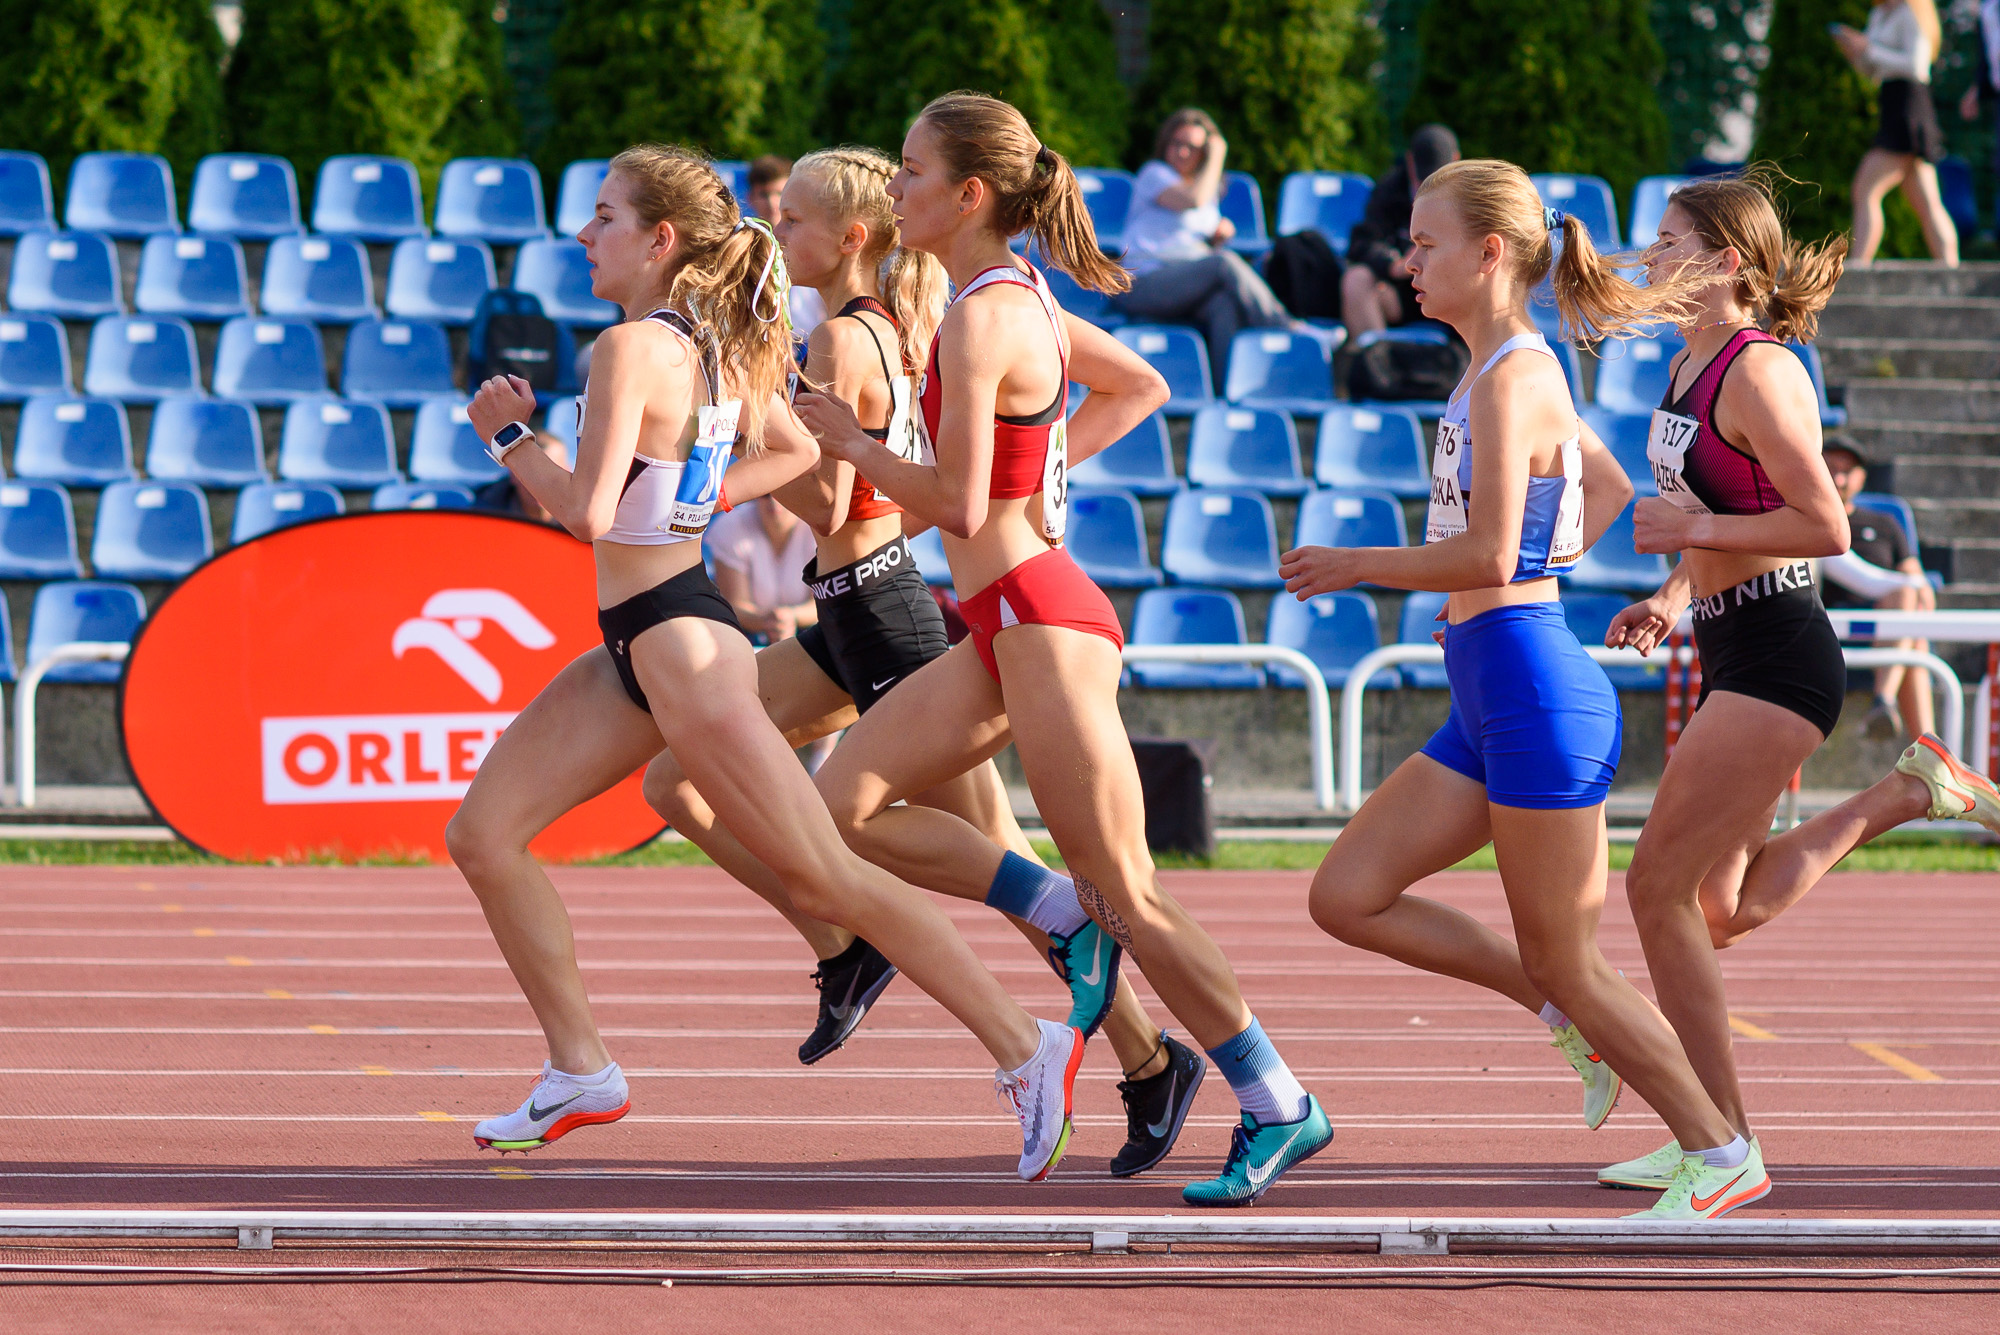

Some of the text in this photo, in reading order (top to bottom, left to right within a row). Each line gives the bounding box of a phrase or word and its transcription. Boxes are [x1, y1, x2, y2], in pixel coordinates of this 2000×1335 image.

[1662, 418, 1691, 448] 517
[1053, 459, 1067, 510] 3
[673, 511, 686, 521] 54.
[810, 571, 852, 600] NIKE
[854, 545, 902, 587] PRO
[1692, 590, 1725, 621] PRO
[1735, 560, 1811, 607] NIKE
[283, 731, 504, 787] ORLE
